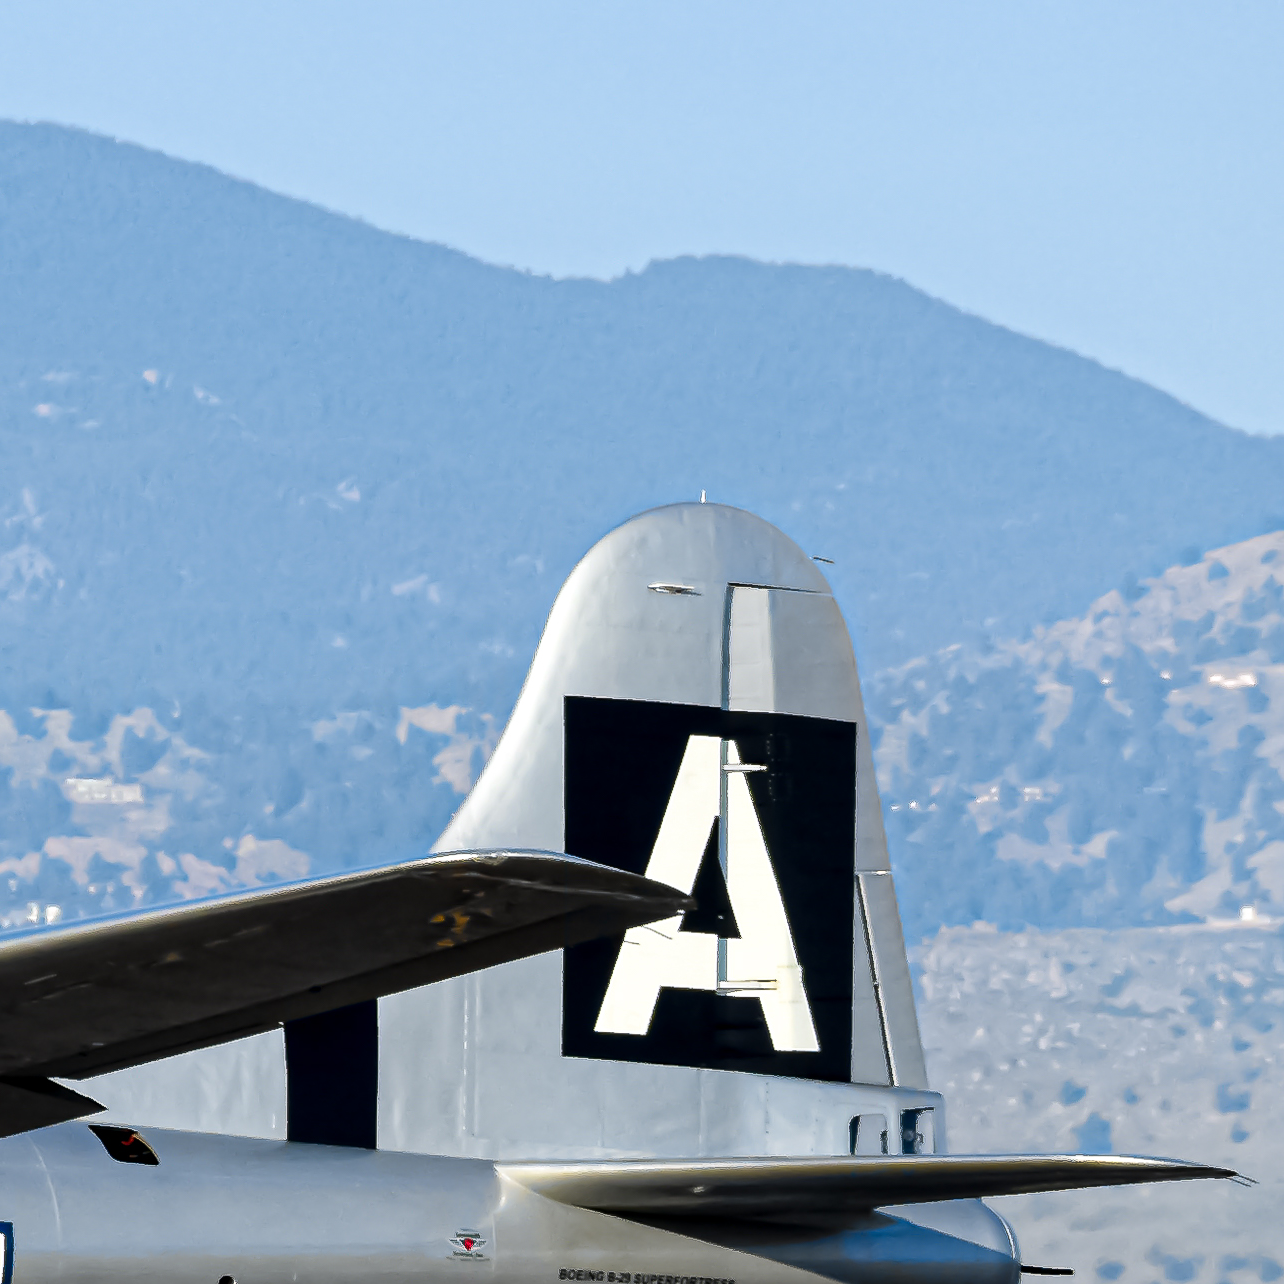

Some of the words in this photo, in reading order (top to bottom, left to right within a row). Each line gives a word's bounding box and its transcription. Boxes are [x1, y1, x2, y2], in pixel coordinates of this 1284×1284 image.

[593, 734, 821, 1053] A
[557, 1268, 605, 1282] BOEING
[606, 1271, 631, 1284] B-29
